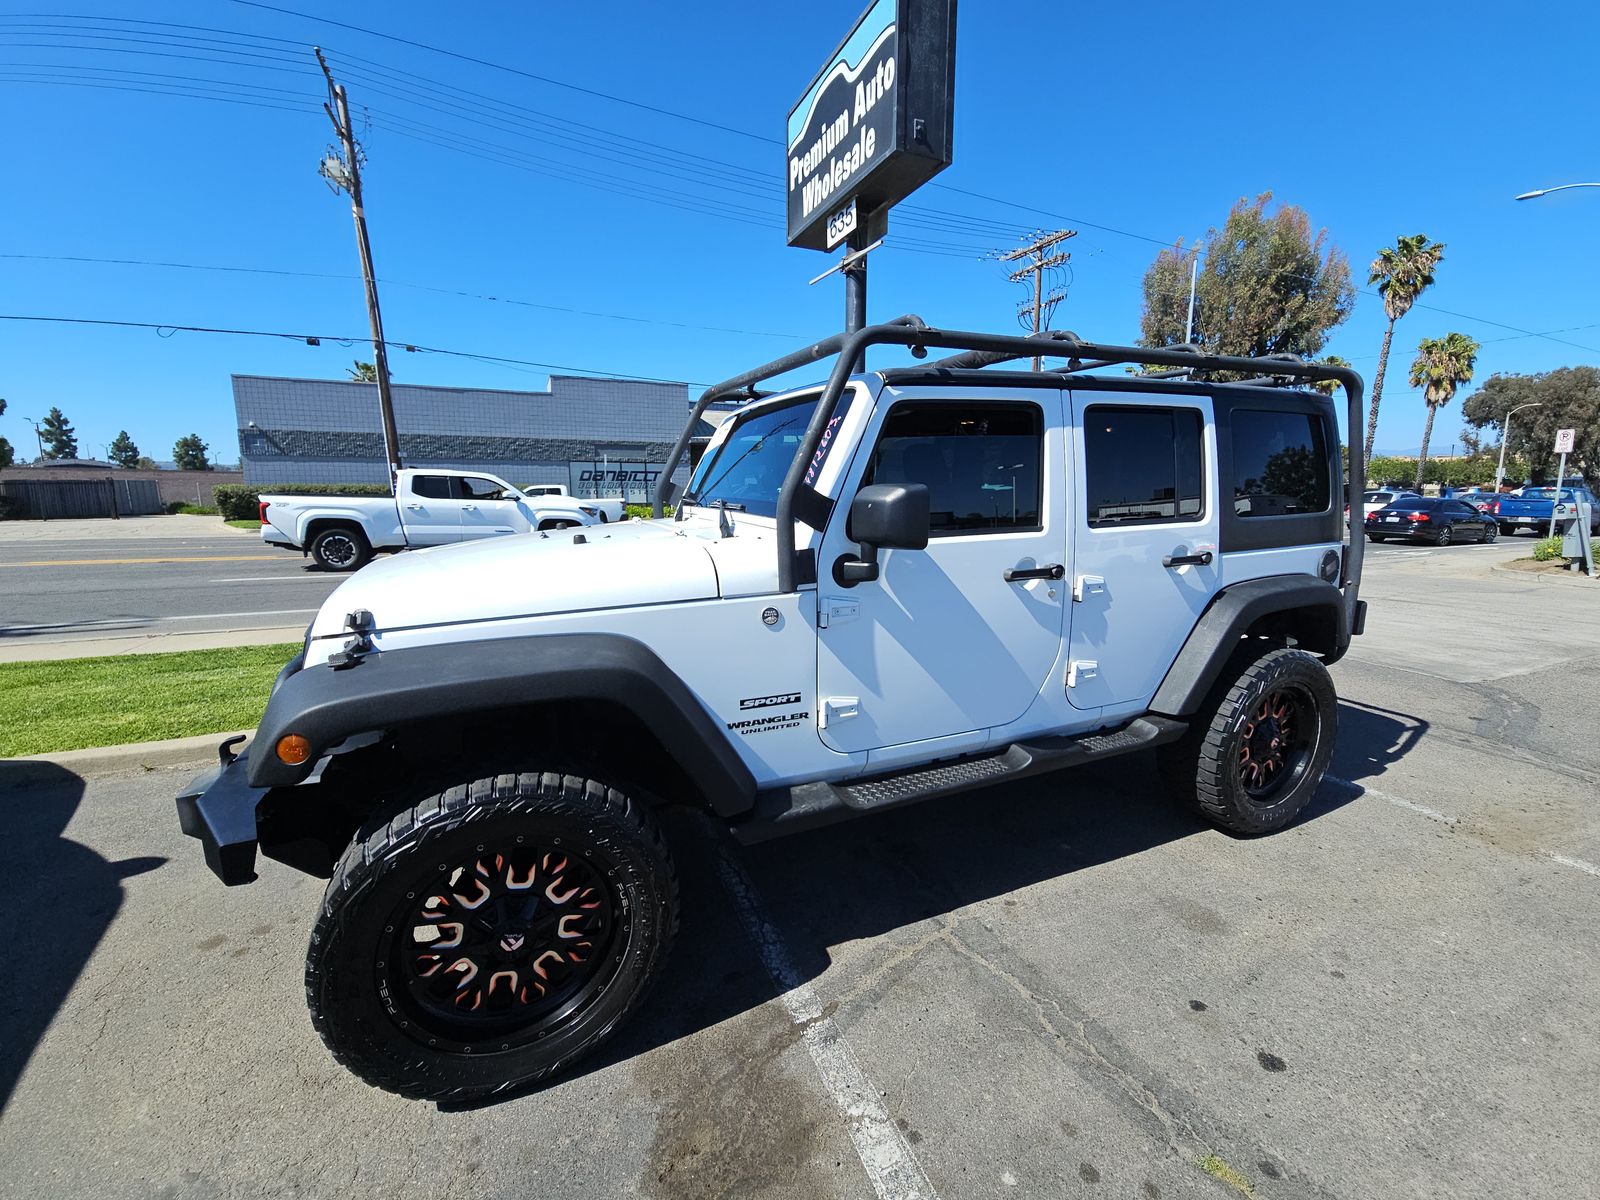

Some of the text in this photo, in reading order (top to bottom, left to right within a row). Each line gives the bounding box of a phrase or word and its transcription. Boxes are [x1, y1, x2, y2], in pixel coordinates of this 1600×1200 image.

[790, 57, 896, 192] Premium Auto
[802, 124, 876, 218] Wholesale
[830, 204, 853, 238] 635
[743, 694, 797, 708] SPORT
[727, 711, 809, 730] WRANGLER
[741, 721, 800, 735] UNLIMITED
[616, 882, 630, 916] FUEL
[380, 979, 397, 1015] FUEL
